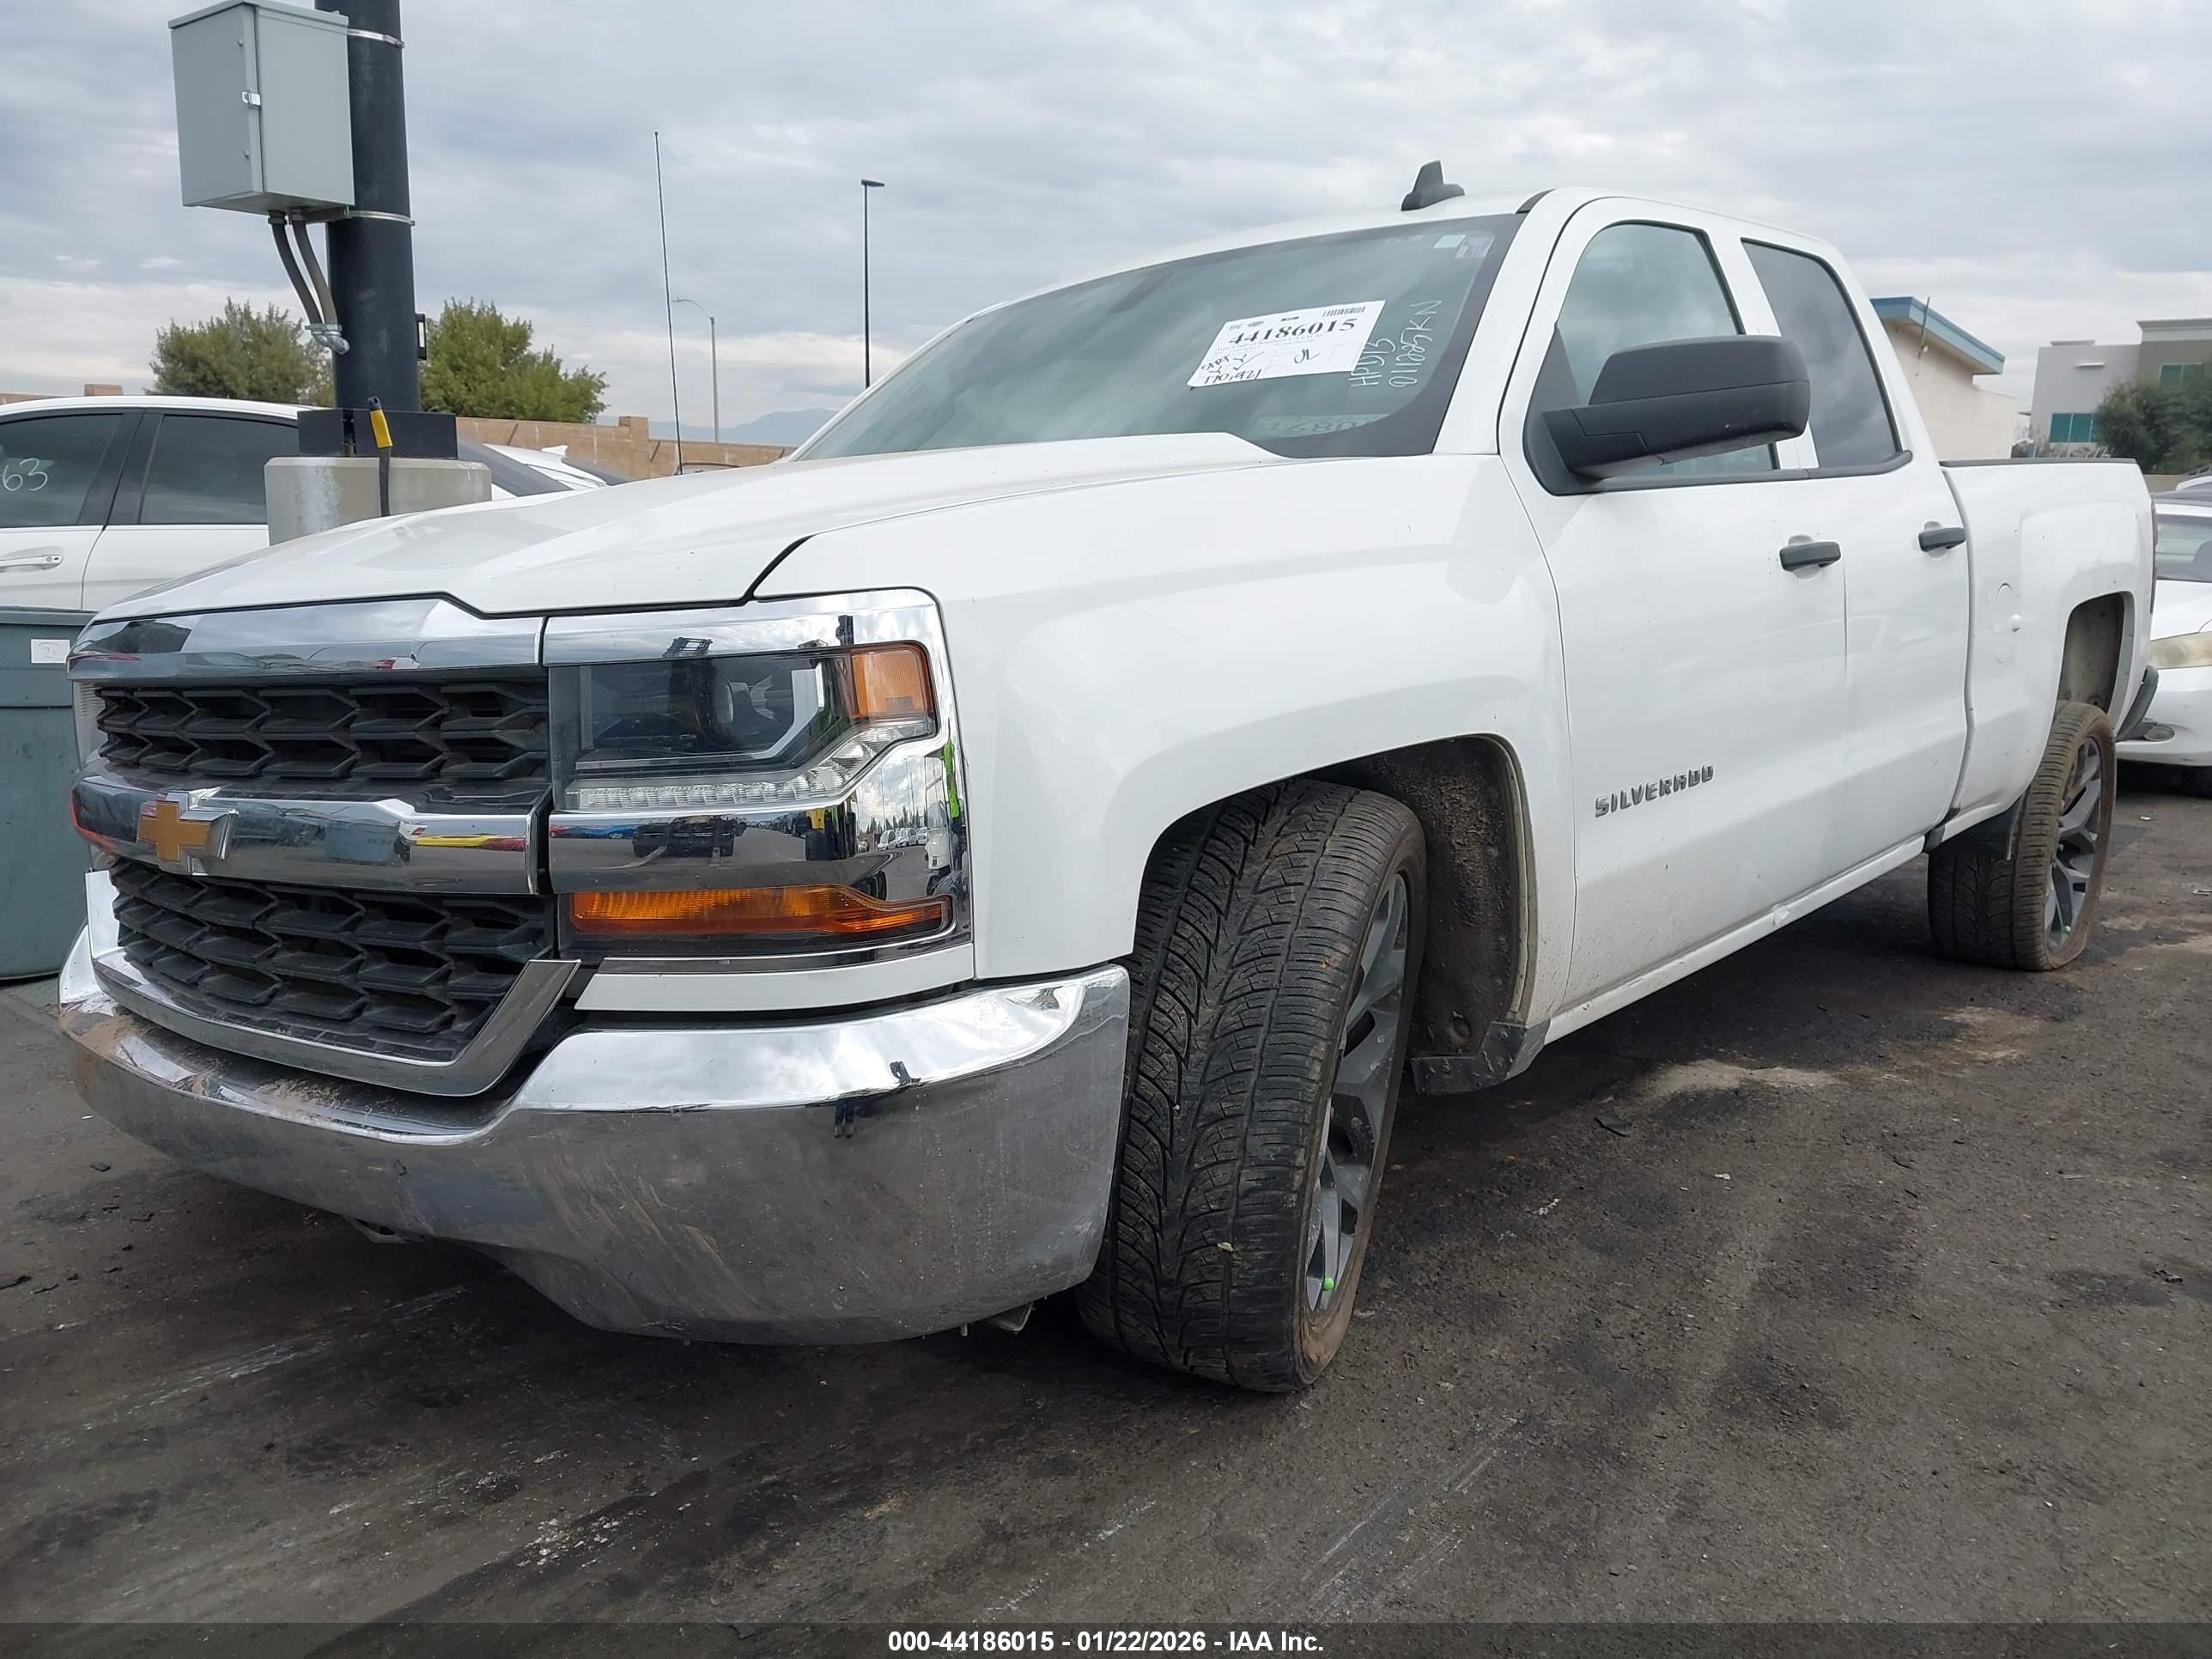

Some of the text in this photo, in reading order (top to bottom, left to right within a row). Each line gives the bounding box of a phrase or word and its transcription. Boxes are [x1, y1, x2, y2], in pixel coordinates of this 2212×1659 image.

[1229, 318, 1358, 344] 44186015
[2, 457, 48, 491] 63
[1595, 764, 1715, 818] SILVERADO
